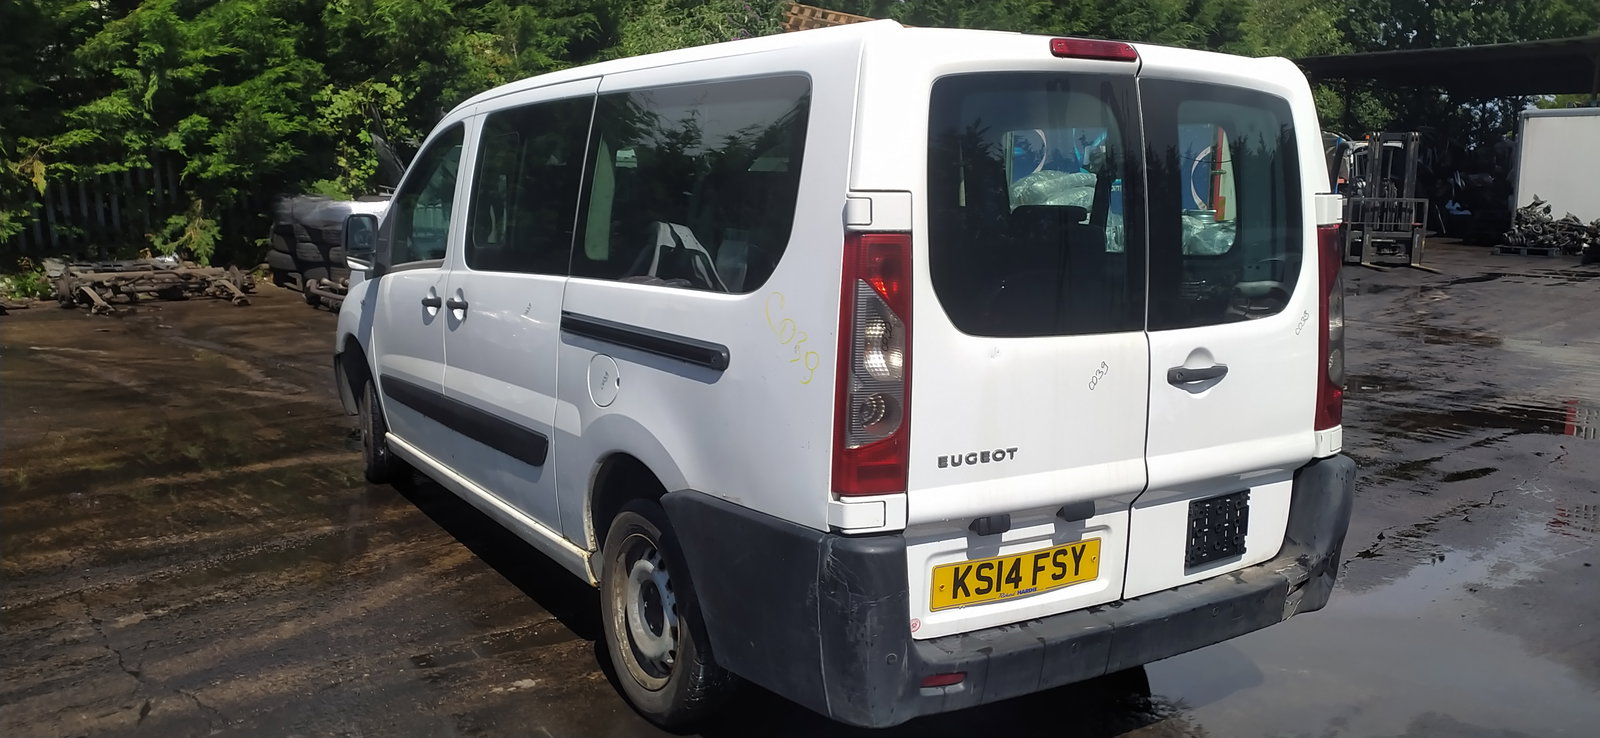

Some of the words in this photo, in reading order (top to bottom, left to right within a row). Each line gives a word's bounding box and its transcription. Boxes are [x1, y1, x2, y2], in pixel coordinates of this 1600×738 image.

[937, 447, 1018, 469] EUGEOT
[952, 557, 1022, 600] KS14
[1031, 544, 1087, 586] FSY
